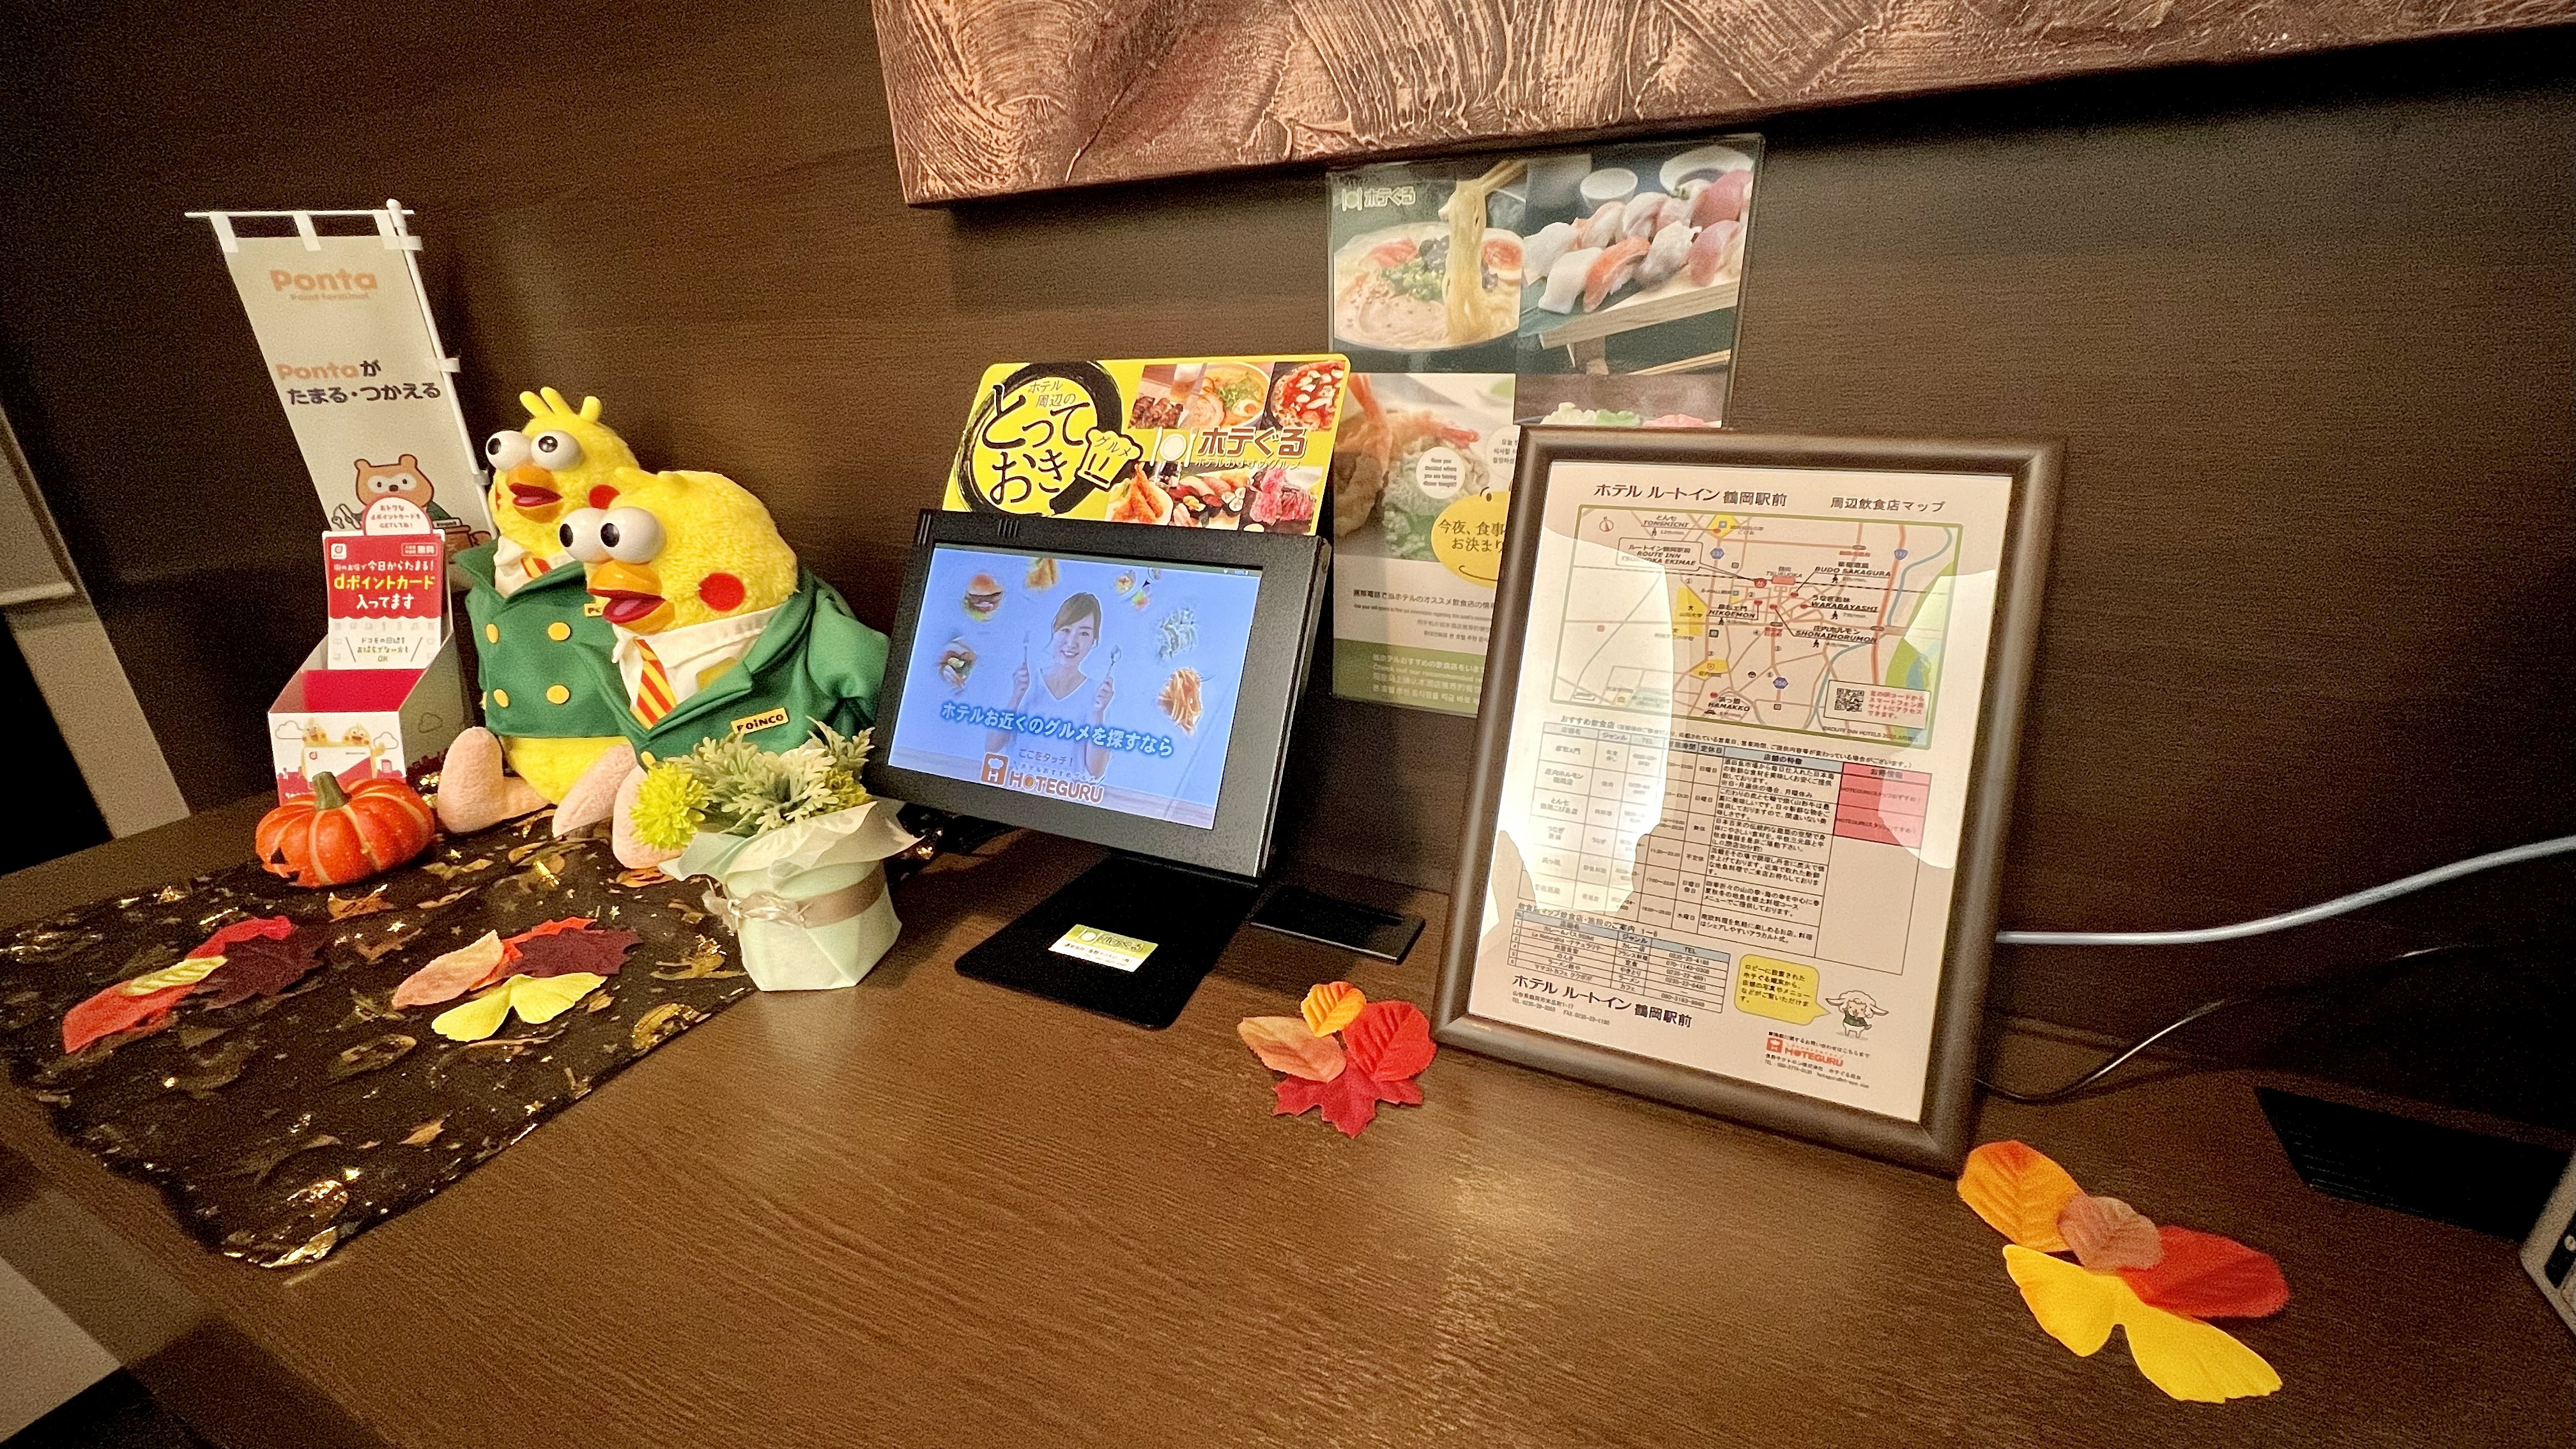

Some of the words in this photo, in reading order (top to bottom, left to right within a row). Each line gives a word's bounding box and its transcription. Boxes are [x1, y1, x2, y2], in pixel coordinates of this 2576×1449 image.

[1364, 186, 1416, 208] ホテぐる
[270, 269, 378, 291] Ponta
[275, 359, 381, 380] Pontaが
[287, 382, 441, 404] たまる・つかえる
[1028, 379, 1064, 394] ホテル
[1036, 393, 1076, 408] 周辺の
[982, 385, 1090, 449] とって
[1197, 426, 1307, 458] ホテぐる
[990, 449, 1068, 505] おき
[1593, 484, 1643, 498] ホテル
[1647, 486, 1721, 502] ルートイン
[1723, 490, 1788, 507] 鶴岡駅前
[1830, 496, 1946, 512] 周辺飲食店マップ
[334, 573, 436, 591] dポイントカード
[356, 594, 415, 610] 入ってます
[941, 702, 1174, 756] ホテルお近くのグルメを探すなら
[1018, 748, 1074, 767] ここをタッチ！
[1701, 744, 1722, 754] 定休日
[1009, 770, 1103, 803] HOTEGURU
[1682, 880, 1700, 889] 日曜日
[1622, 935, 1648, 944] ジャンル
[1620, 984, 1636, 992] カフェ
[1512, 975, 1558, 994] ホテル
[1563, 986, 1632, 1010] ルートイン
[1634, 1004, 1692, 1028] 鶴岡駅前
[1785, 1047, 1844, 1067] HOTEGURU
